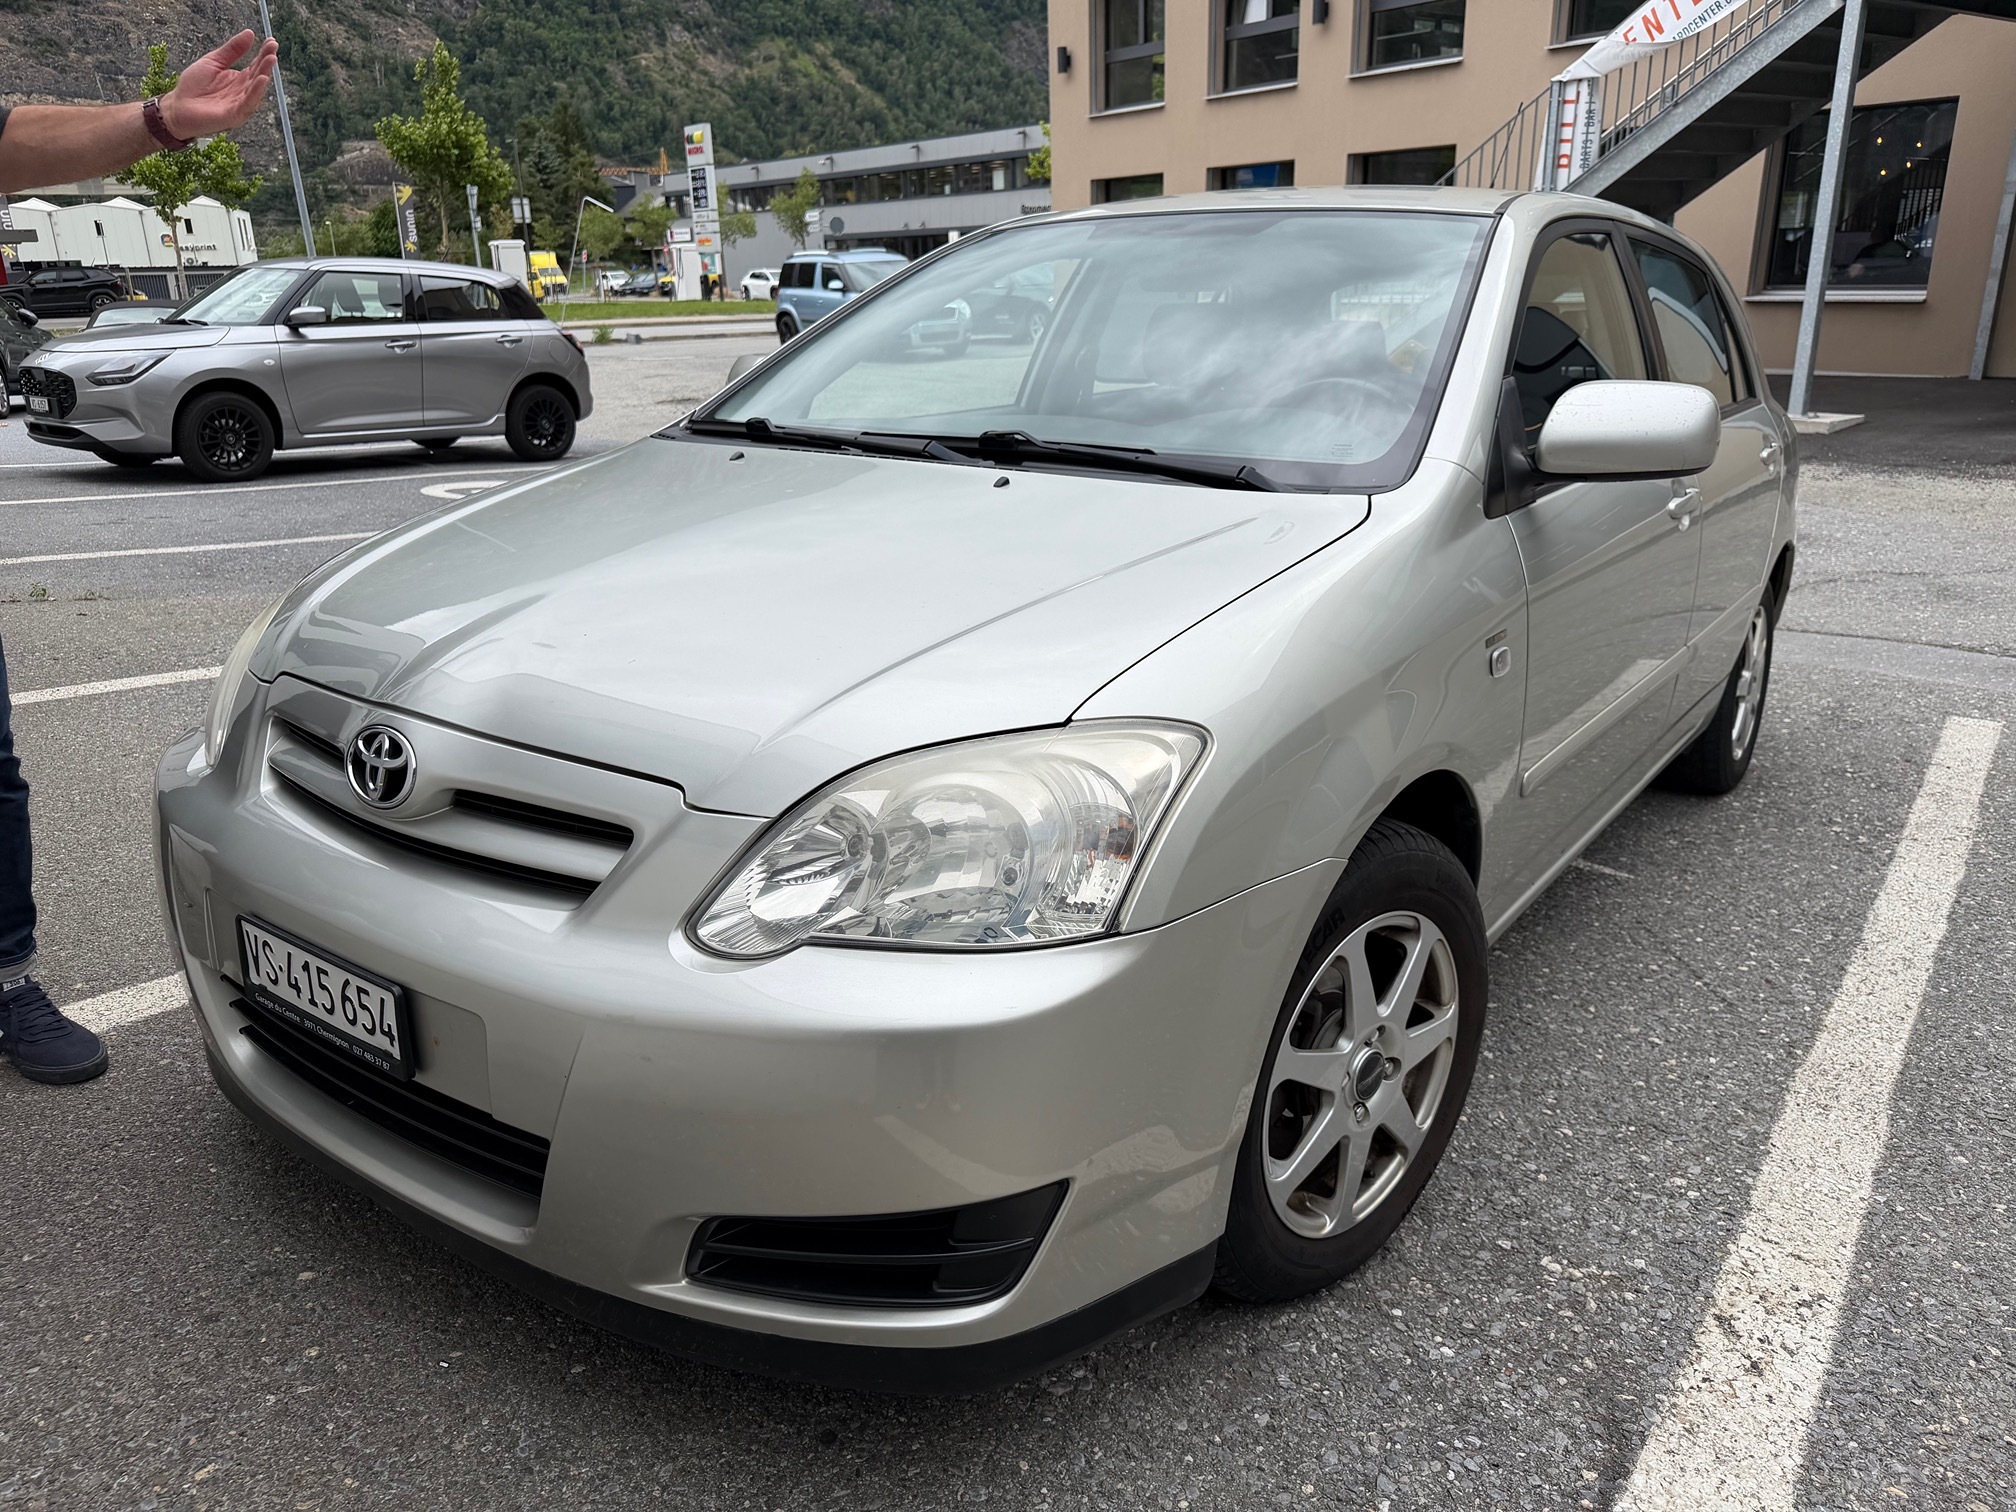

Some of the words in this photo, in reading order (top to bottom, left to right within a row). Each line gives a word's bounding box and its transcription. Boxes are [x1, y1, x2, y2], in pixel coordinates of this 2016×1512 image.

[405, 209, 418, 243] sunin
[179, 243, 217, 252] asyprint
[255, 992, 275, 1009] Garage
[274, 1003, 283, 1013] du
[282, 1007, 301, 1023] Centre
[303, 1018, 317, 1032] 3971
[316, 1025, 350, 1050] Chermignon
[352, 1045, 364, 1056] 027
[363, 1051, 375, 1063] 483
[374, 1056, 382, 1067] 37
[382, 1061, 390, 1071] 87
